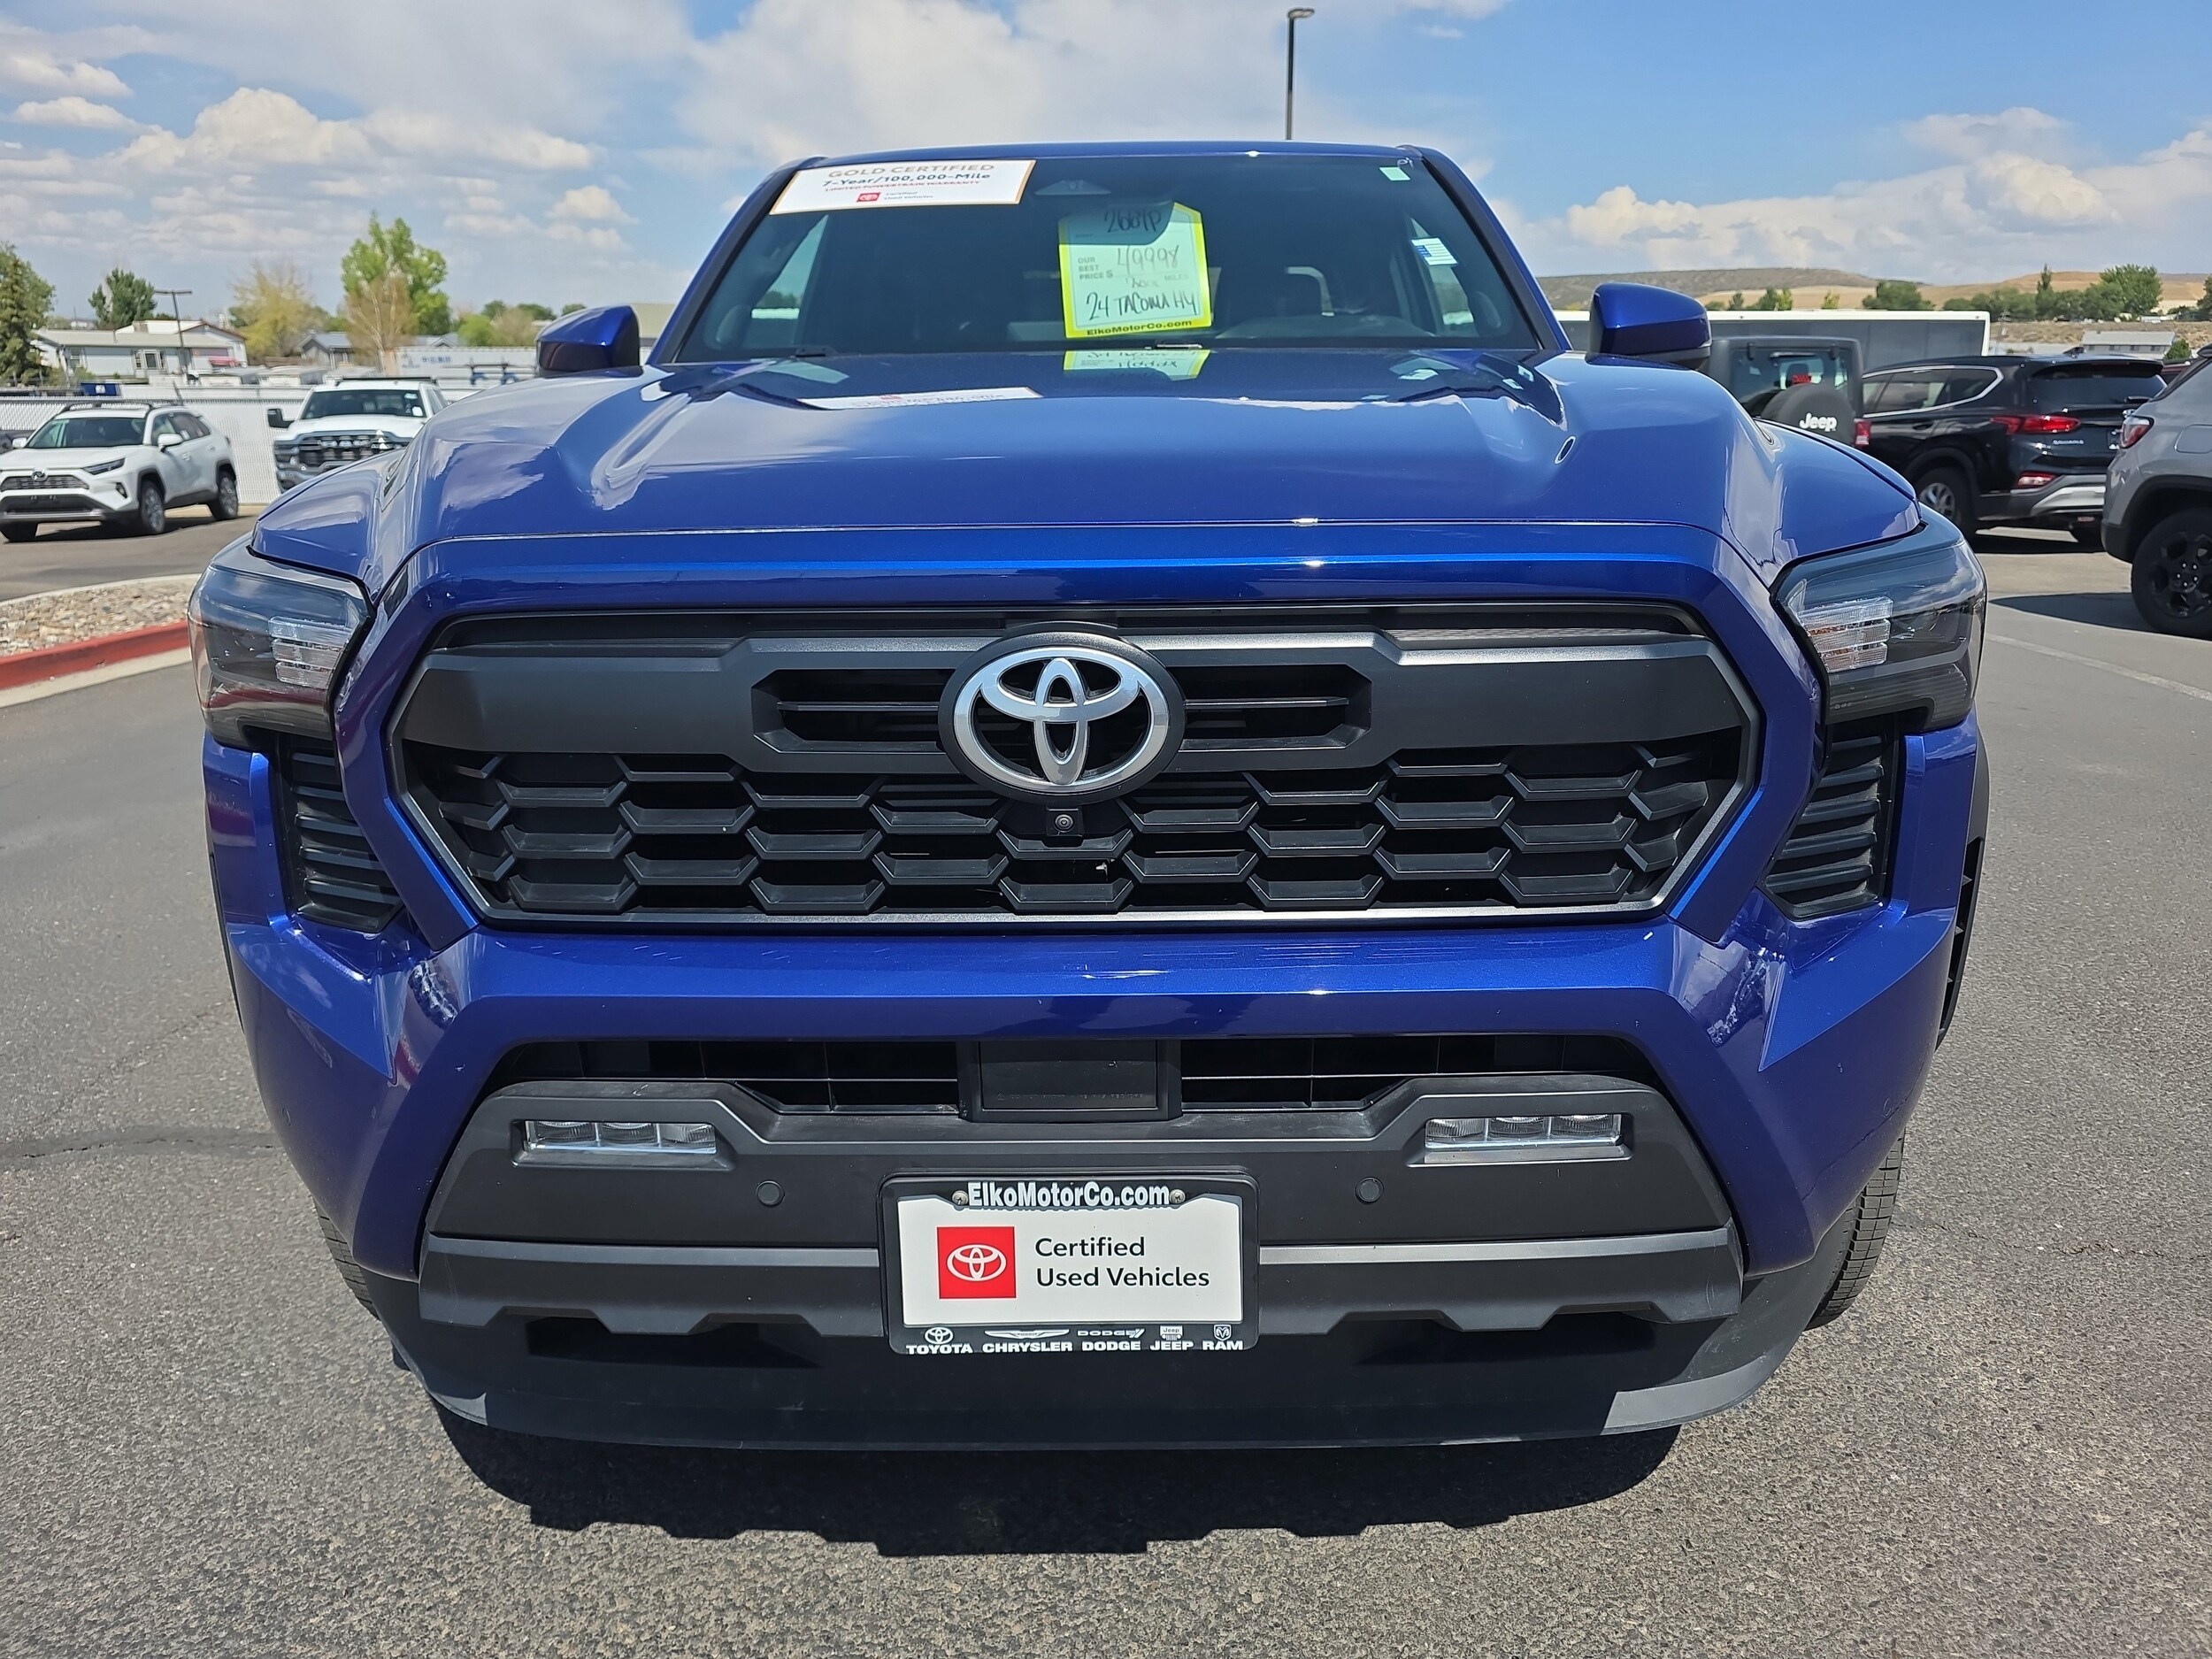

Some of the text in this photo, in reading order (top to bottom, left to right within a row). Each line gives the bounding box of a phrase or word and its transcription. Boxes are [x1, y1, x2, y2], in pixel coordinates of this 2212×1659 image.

[823, 173, 991, 187] 7-Year/100,000-Mile
[828, 165, 995, 177] GOLD CERTIFIED
[1086, 291, 1110, 321] 24
[1087, 320, 1193, 336] ElkoMotorCo.com
[1799, 412, 1838, 432] Jeep
[967, 1180, 1170, 1207] ElkoMotorCo.com
[1034, 1236, 1145, 1257] Certified
[1036, 1266, 1210, 1287] Used Vehicles
[906, 1340, 1243, 1355] TOYOTA CHRYSLER DODGE JEEP RAM
